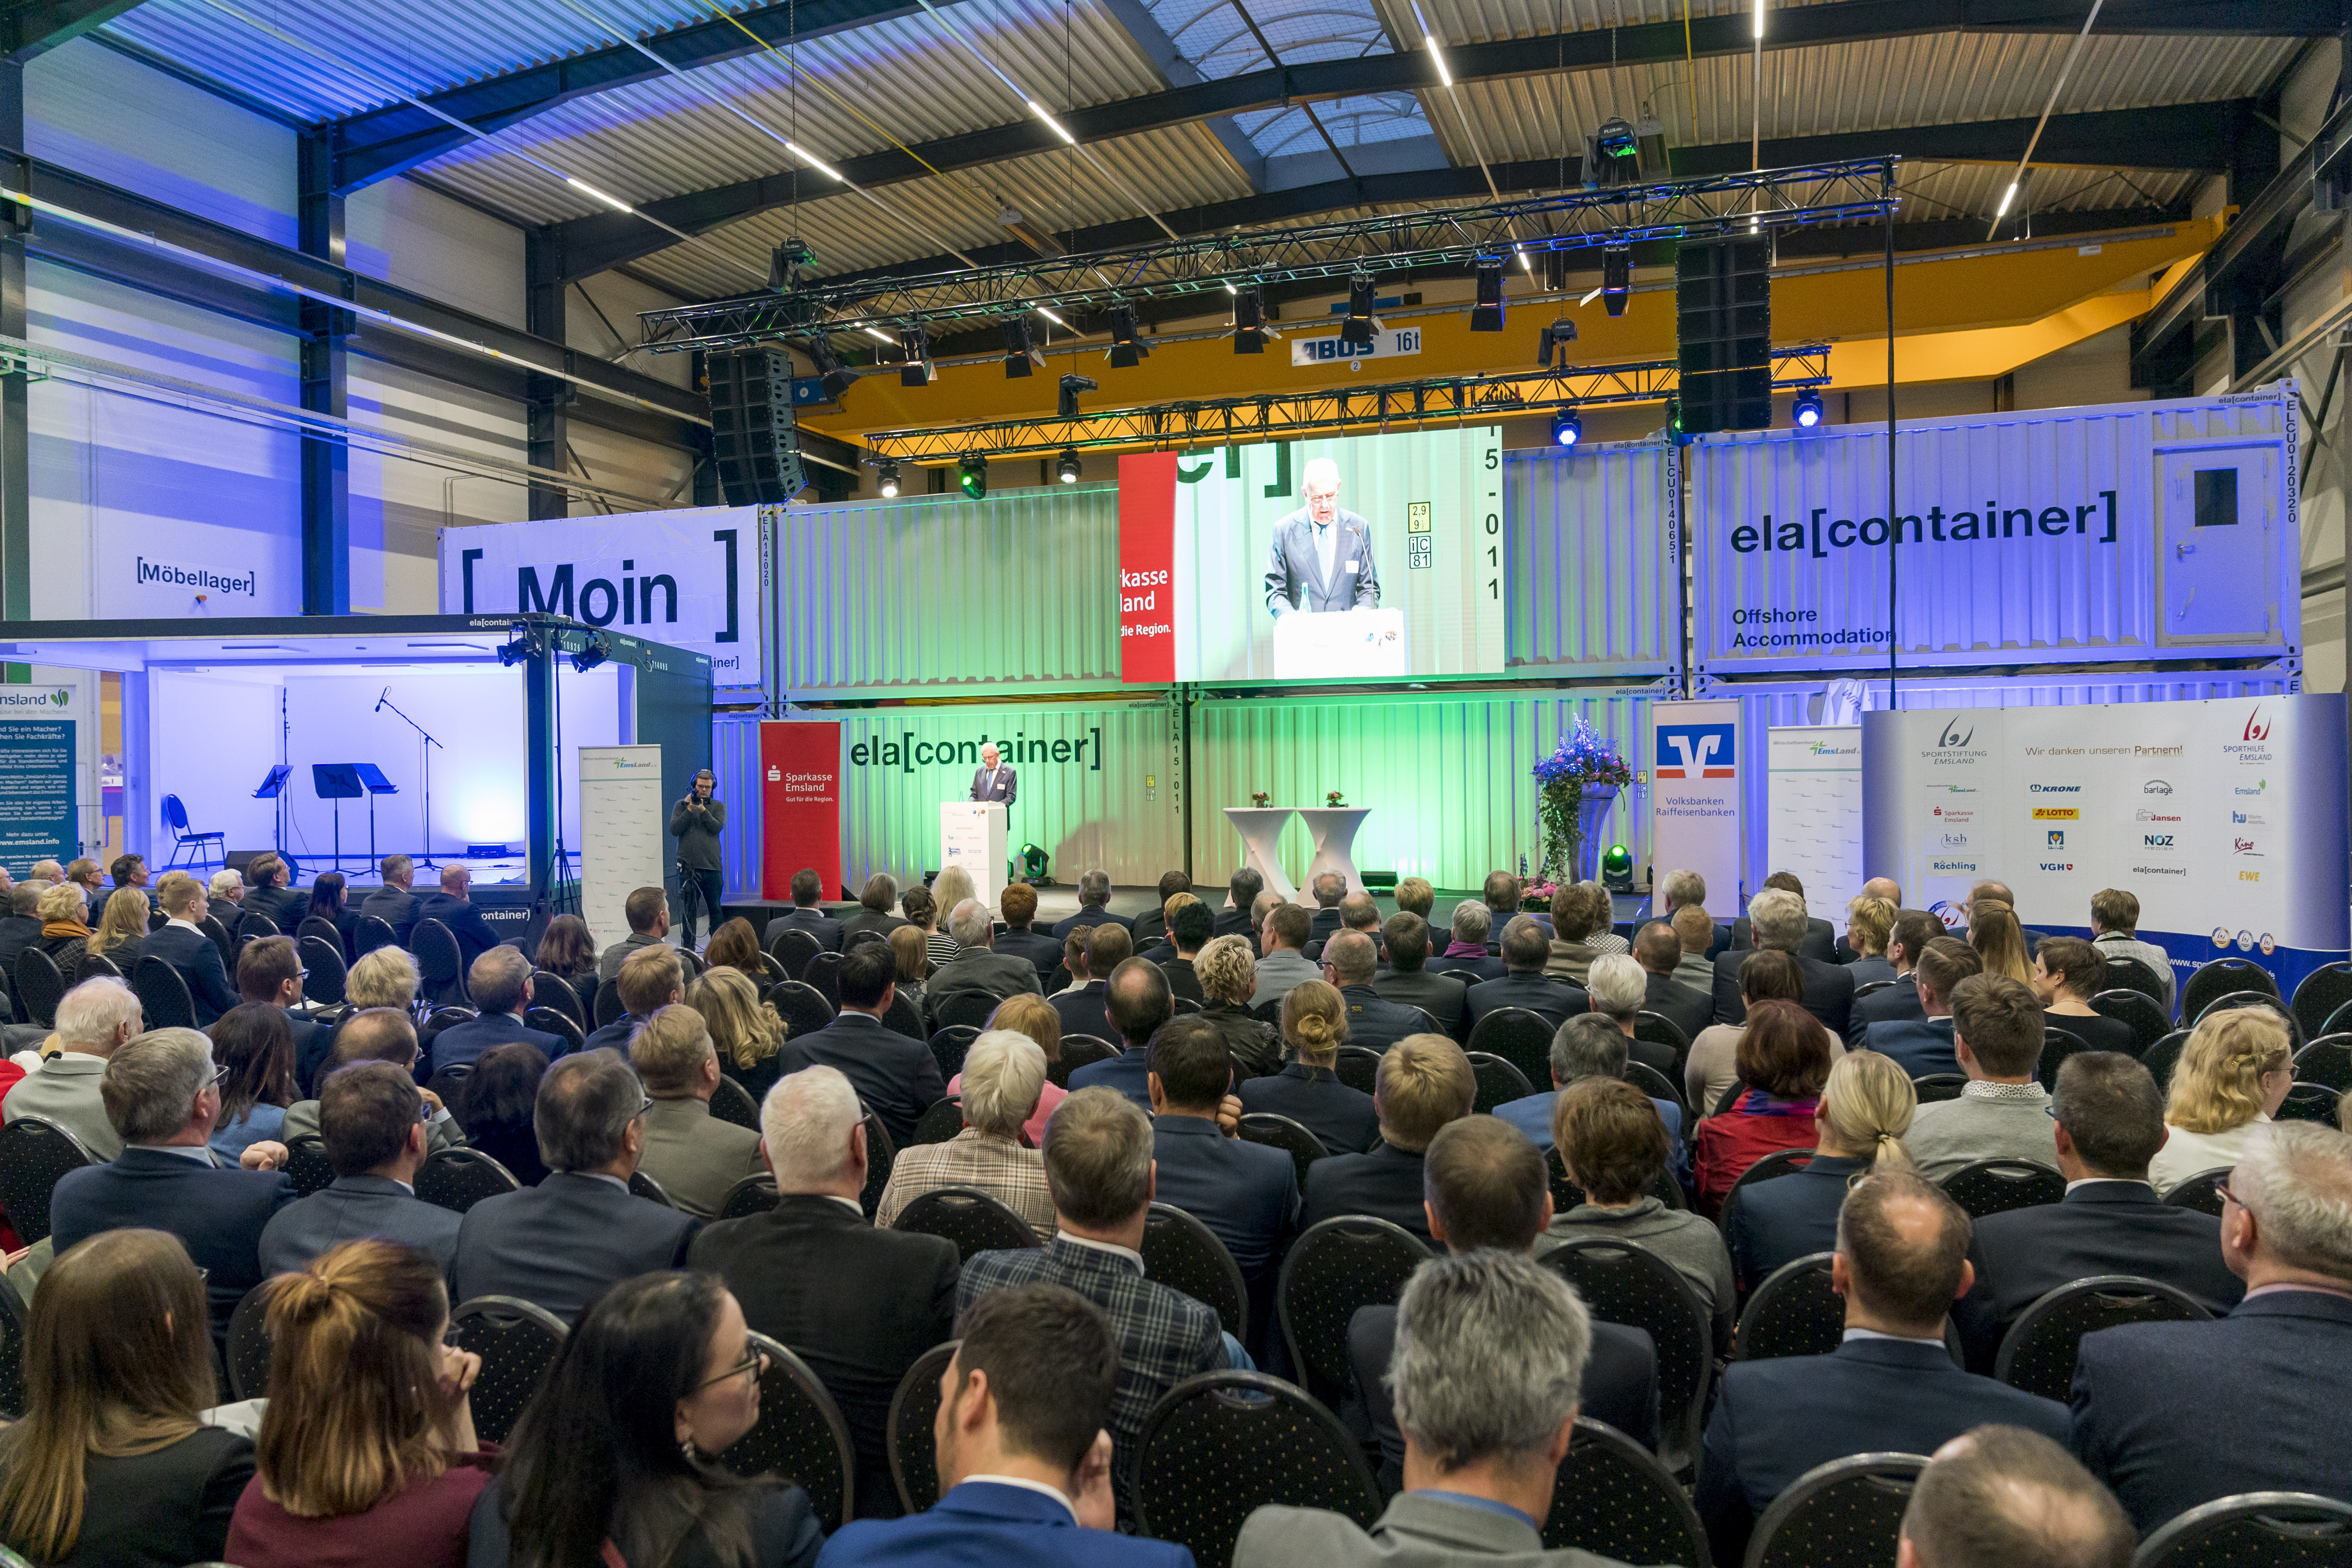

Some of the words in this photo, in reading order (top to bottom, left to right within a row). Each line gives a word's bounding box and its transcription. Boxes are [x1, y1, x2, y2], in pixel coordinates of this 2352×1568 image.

[2219, 393, 2281, 404] ela[container]
[1614, 439, 1663, 449] ela[container]
[1730, 490, 2117, 558] ela[container]
[1413, 554, 1427, 567] 81
[137, 557, 255, 596] [Möbellager]
[1120, 569, 1168, 587] kasse
[1732, 608, 1817, 625] Offshore
[1136, 622, 1171, 637] Region.
[1616, 687, 1665, 696] ela[container]
[2025, 747, 2045, 755] Wir
[2048, 747, 2085, 755] danken
[2135, 745, 2183, 754] Partnern!
[786, 772, 832, 783] Sparkasse
[786, 783, 824, 791] Emsland
[2144, 785, 2173, 795] barlage
[1656, 808, 1735, 816] Raiffeisenbanken
[2145, 835, 2173, 846] NOZ
[2235, 837, 2254, 850] Kino
[1934, 860, 1976, 871] Röchling
[2133, 867, 2186, 876] ela[container]
[2239, 871, 2260, 882] EWE
[481, 909, 531, 921] ontainer]
